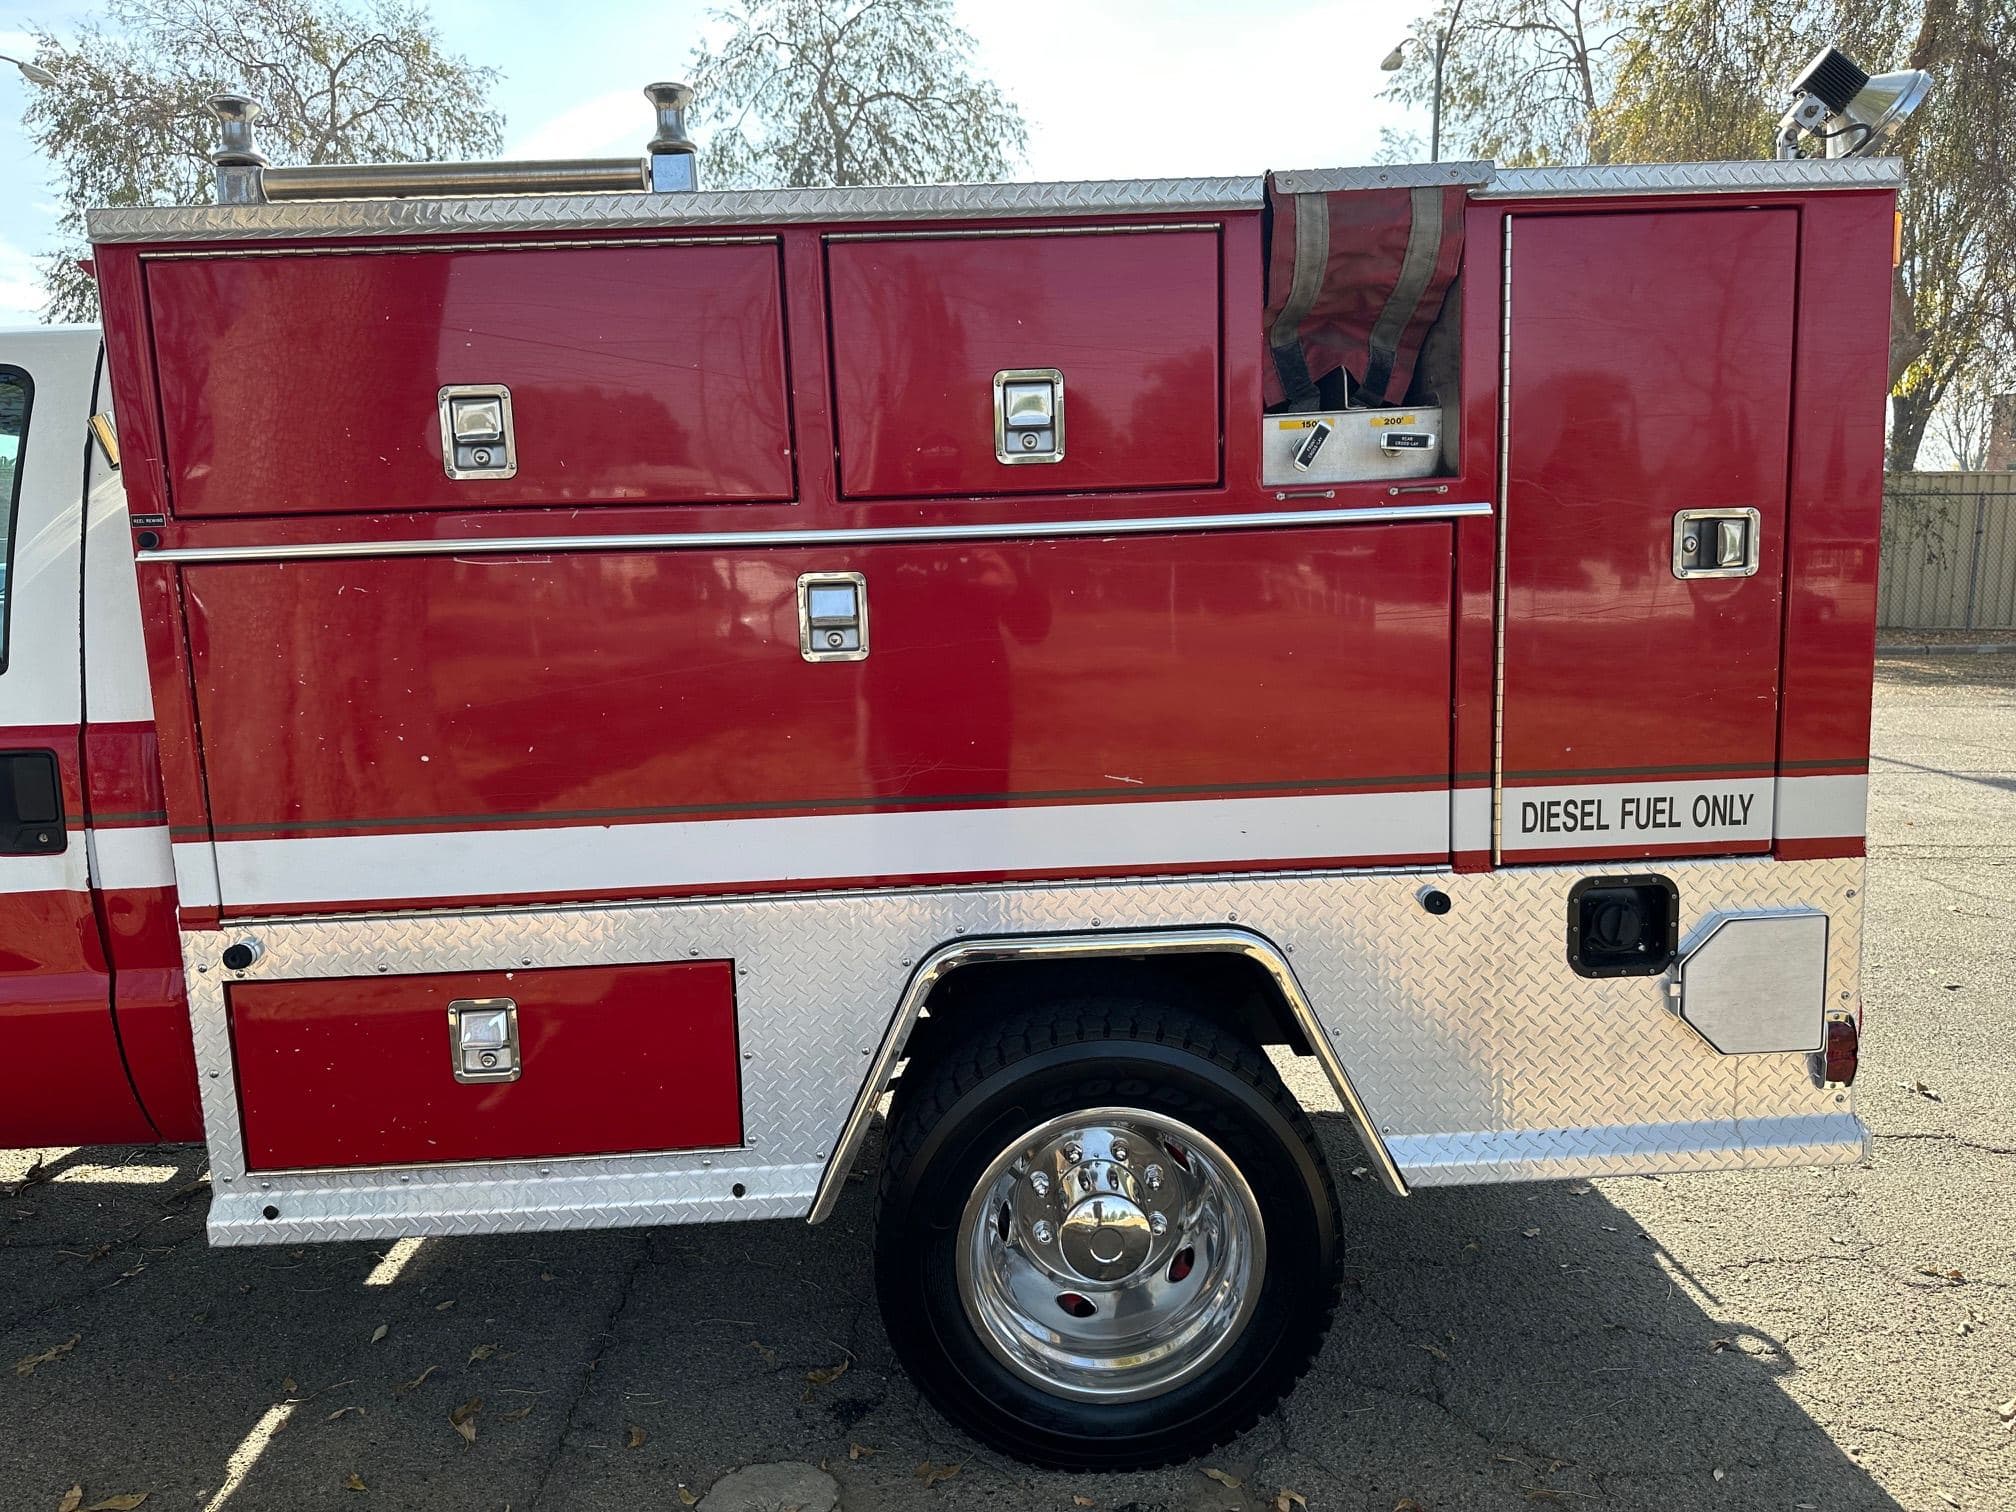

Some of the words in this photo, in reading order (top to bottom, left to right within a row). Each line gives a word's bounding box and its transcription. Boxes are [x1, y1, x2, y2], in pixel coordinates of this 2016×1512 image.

[1384, 416, 1404, 425] 200'
[1521, 798, 1610, 834] DIESEL
[1620, 796, 1682, 830] FUEL
[1692, 793, 1754, 828] ONLY
